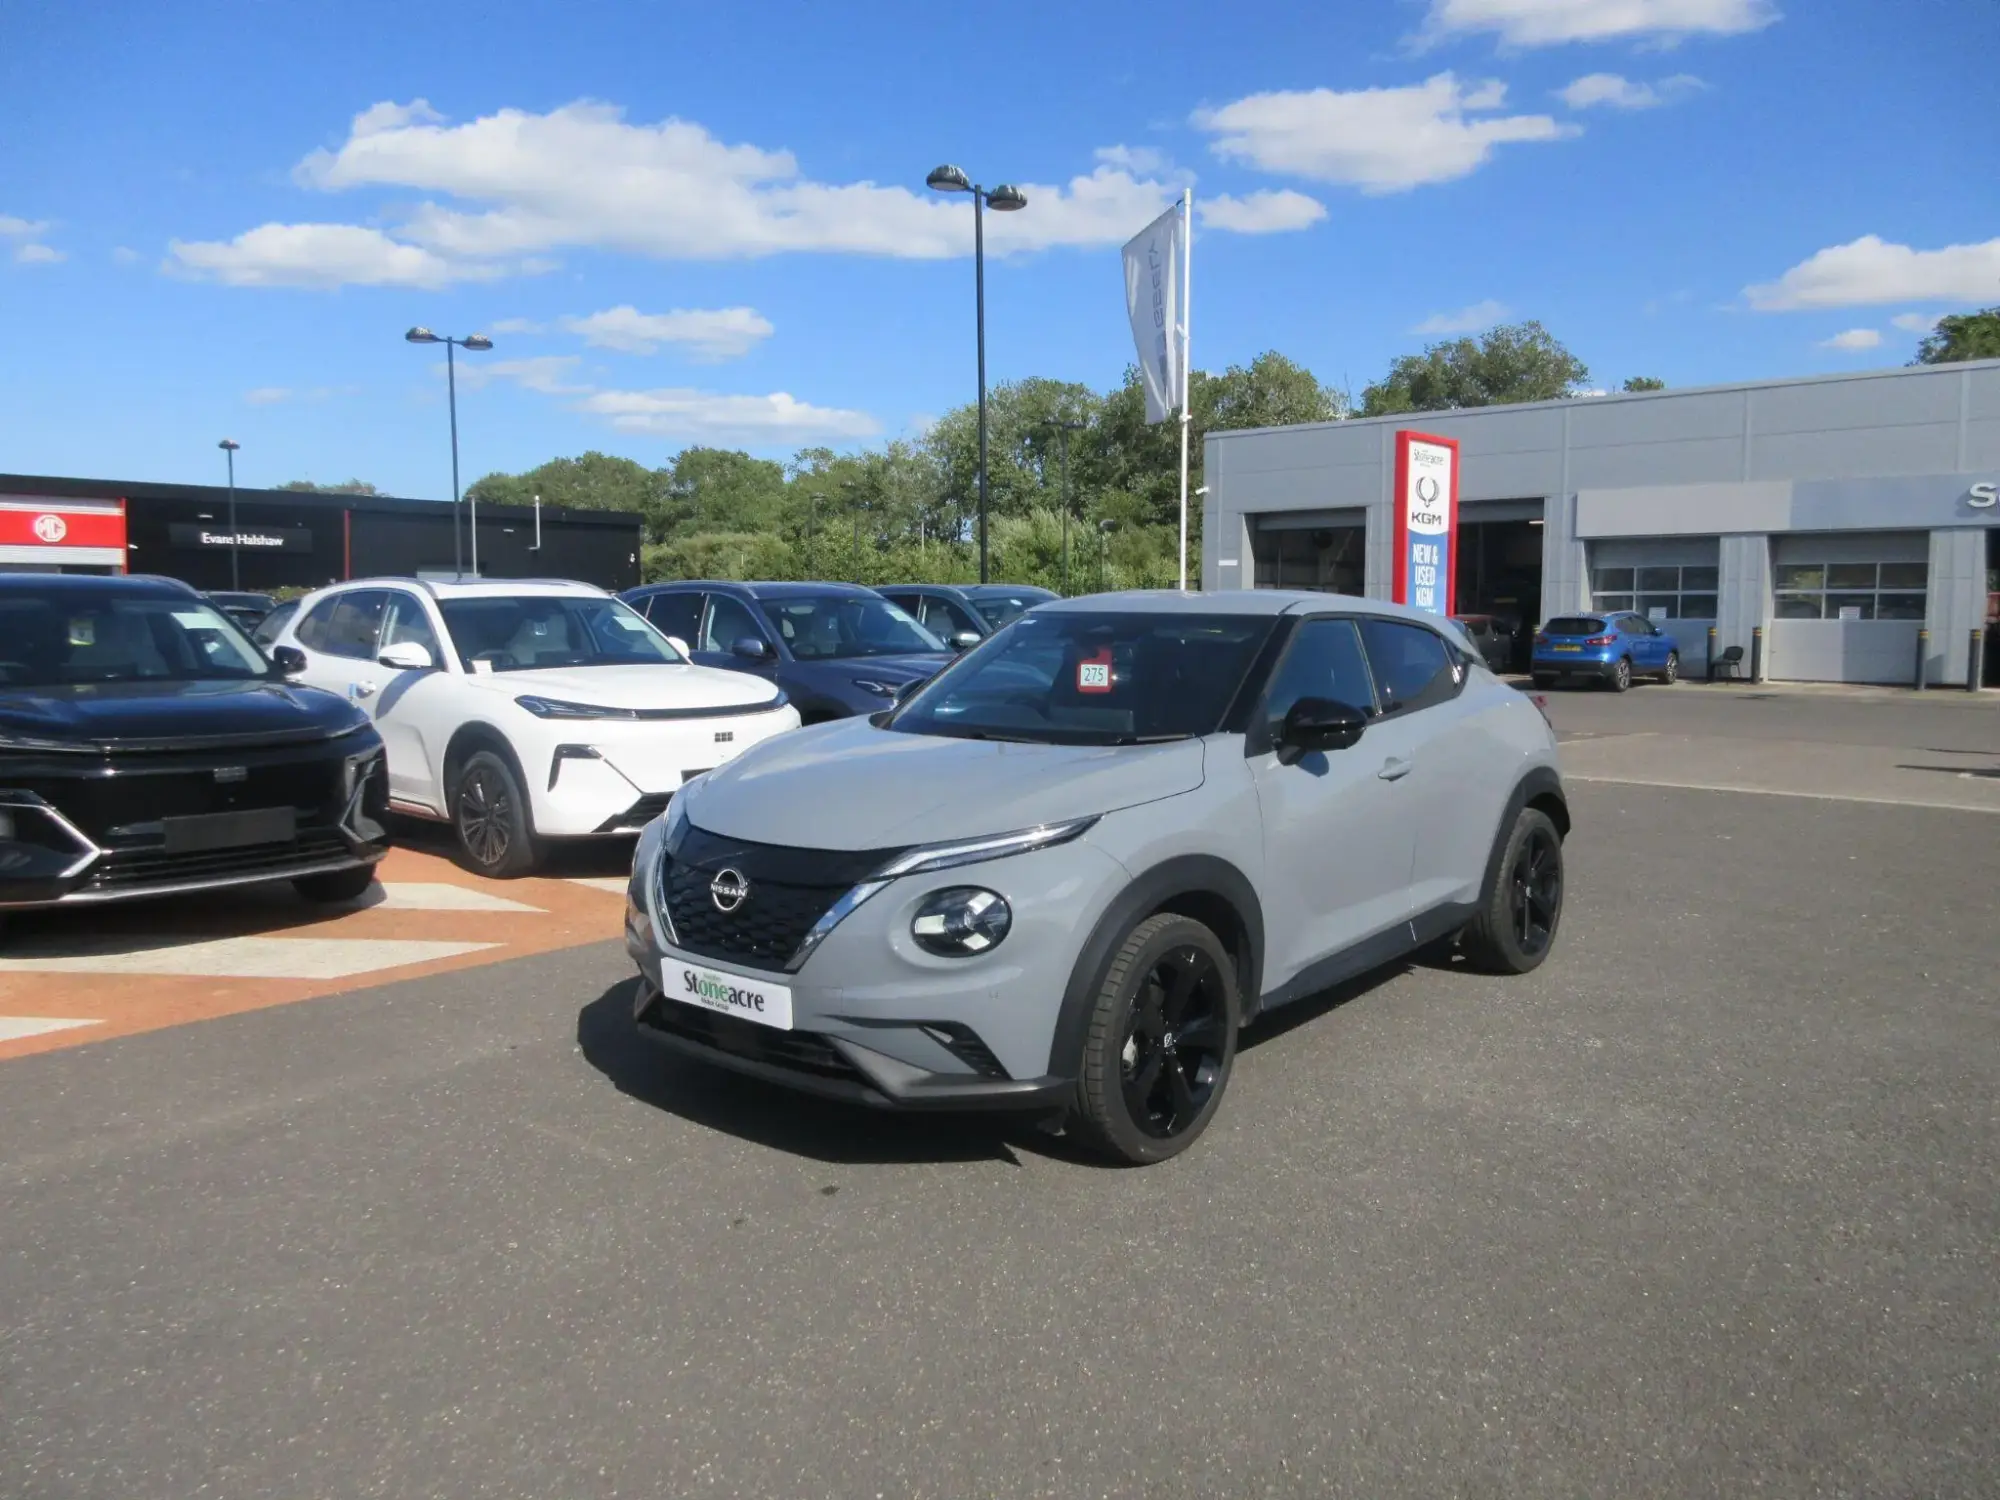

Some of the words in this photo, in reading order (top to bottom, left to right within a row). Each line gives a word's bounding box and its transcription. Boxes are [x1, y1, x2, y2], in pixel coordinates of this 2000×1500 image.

[1967, 482, 2000, 507] S
[37, 515, 66, 541] MG
[1411, 512, 1442, 526] KGM
[201, 532, 234, 544] Evans
[236, 534, 284, 546] Halshaw
[1413, 544, 1432, 564] NEW
[1432, 545, 1438, 565] &
[1415, 565, 1436, 586] USED
[1416, 586, 1433, 607] KGM
[1084, 667, 1104, 682] 275
[711, 883, 746, 897] NISSAN
[684, 970, 765, 1012] Stoneacre
